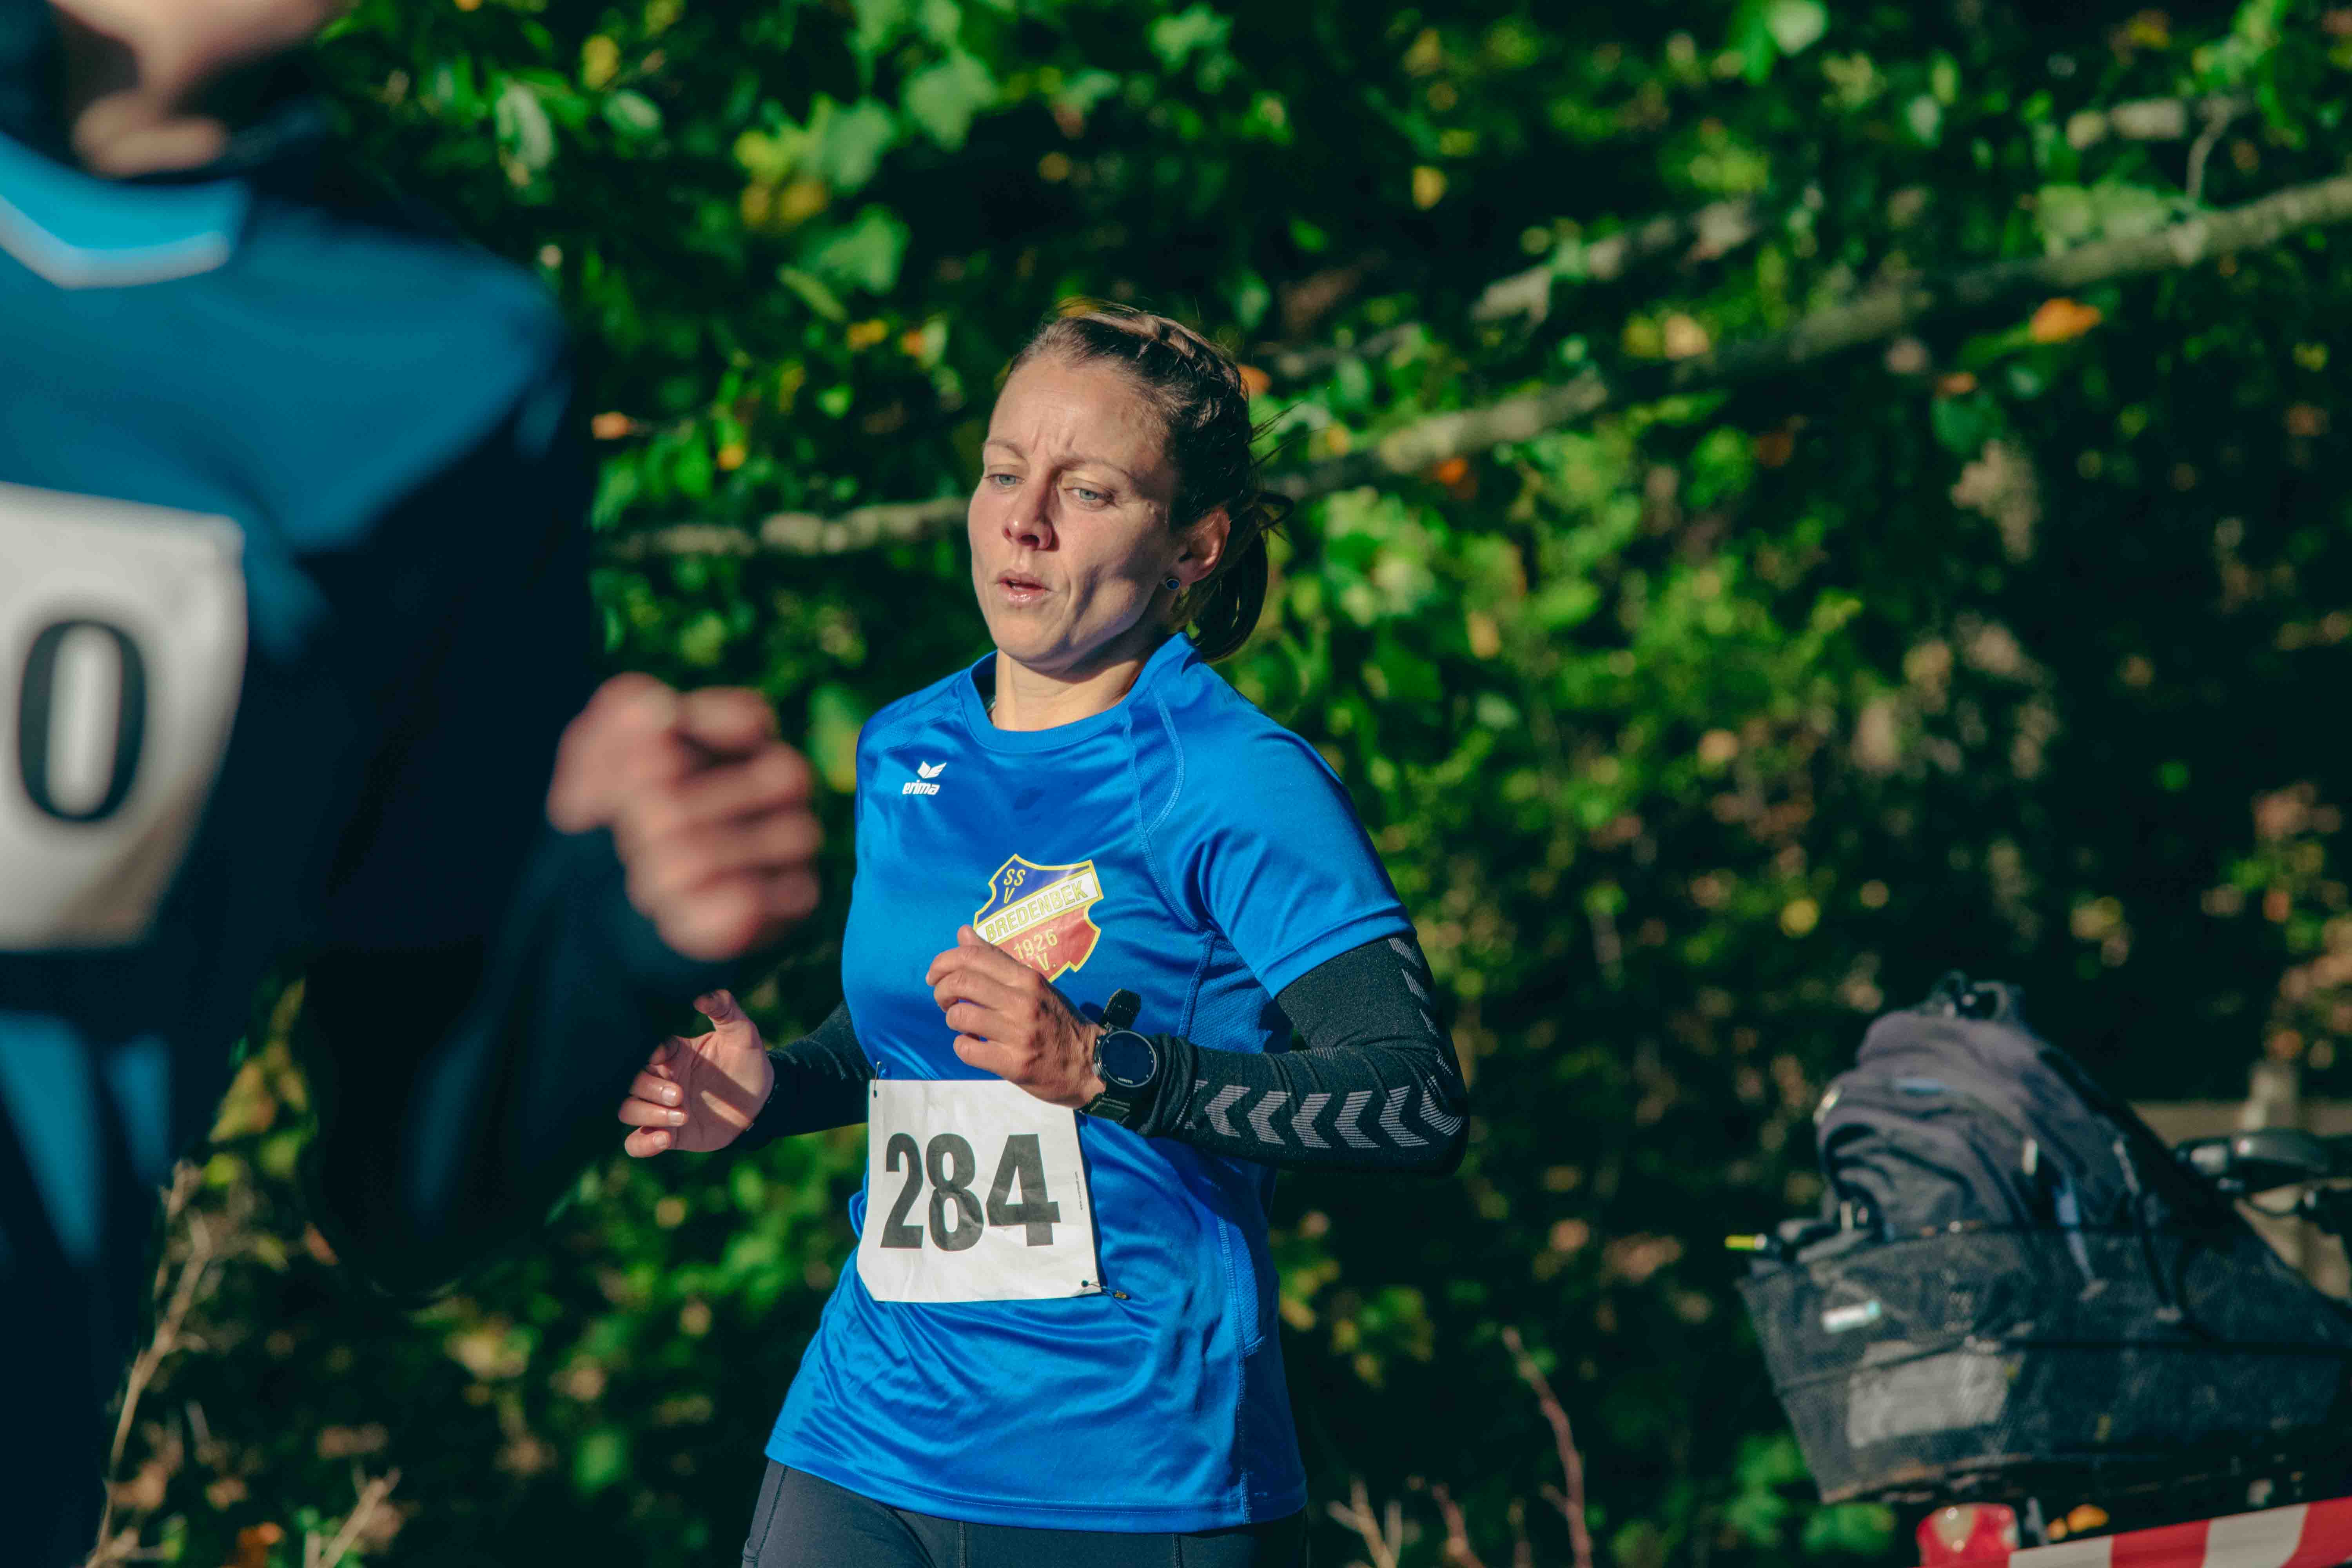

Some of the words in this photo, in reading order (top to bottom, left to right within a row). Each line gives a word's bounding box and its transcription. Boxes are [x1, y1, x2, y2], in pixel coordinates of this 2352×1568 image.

[902, 779, 940, 795] erima
[1003, 868, 1025, 886] SS
[1004, 887, 1015, 903] V
[985, 880, 1088, 942] BREDENBEK
[1013, 928, 1058, 960] 1926
[880, 1132, 1061, 1252] 284
